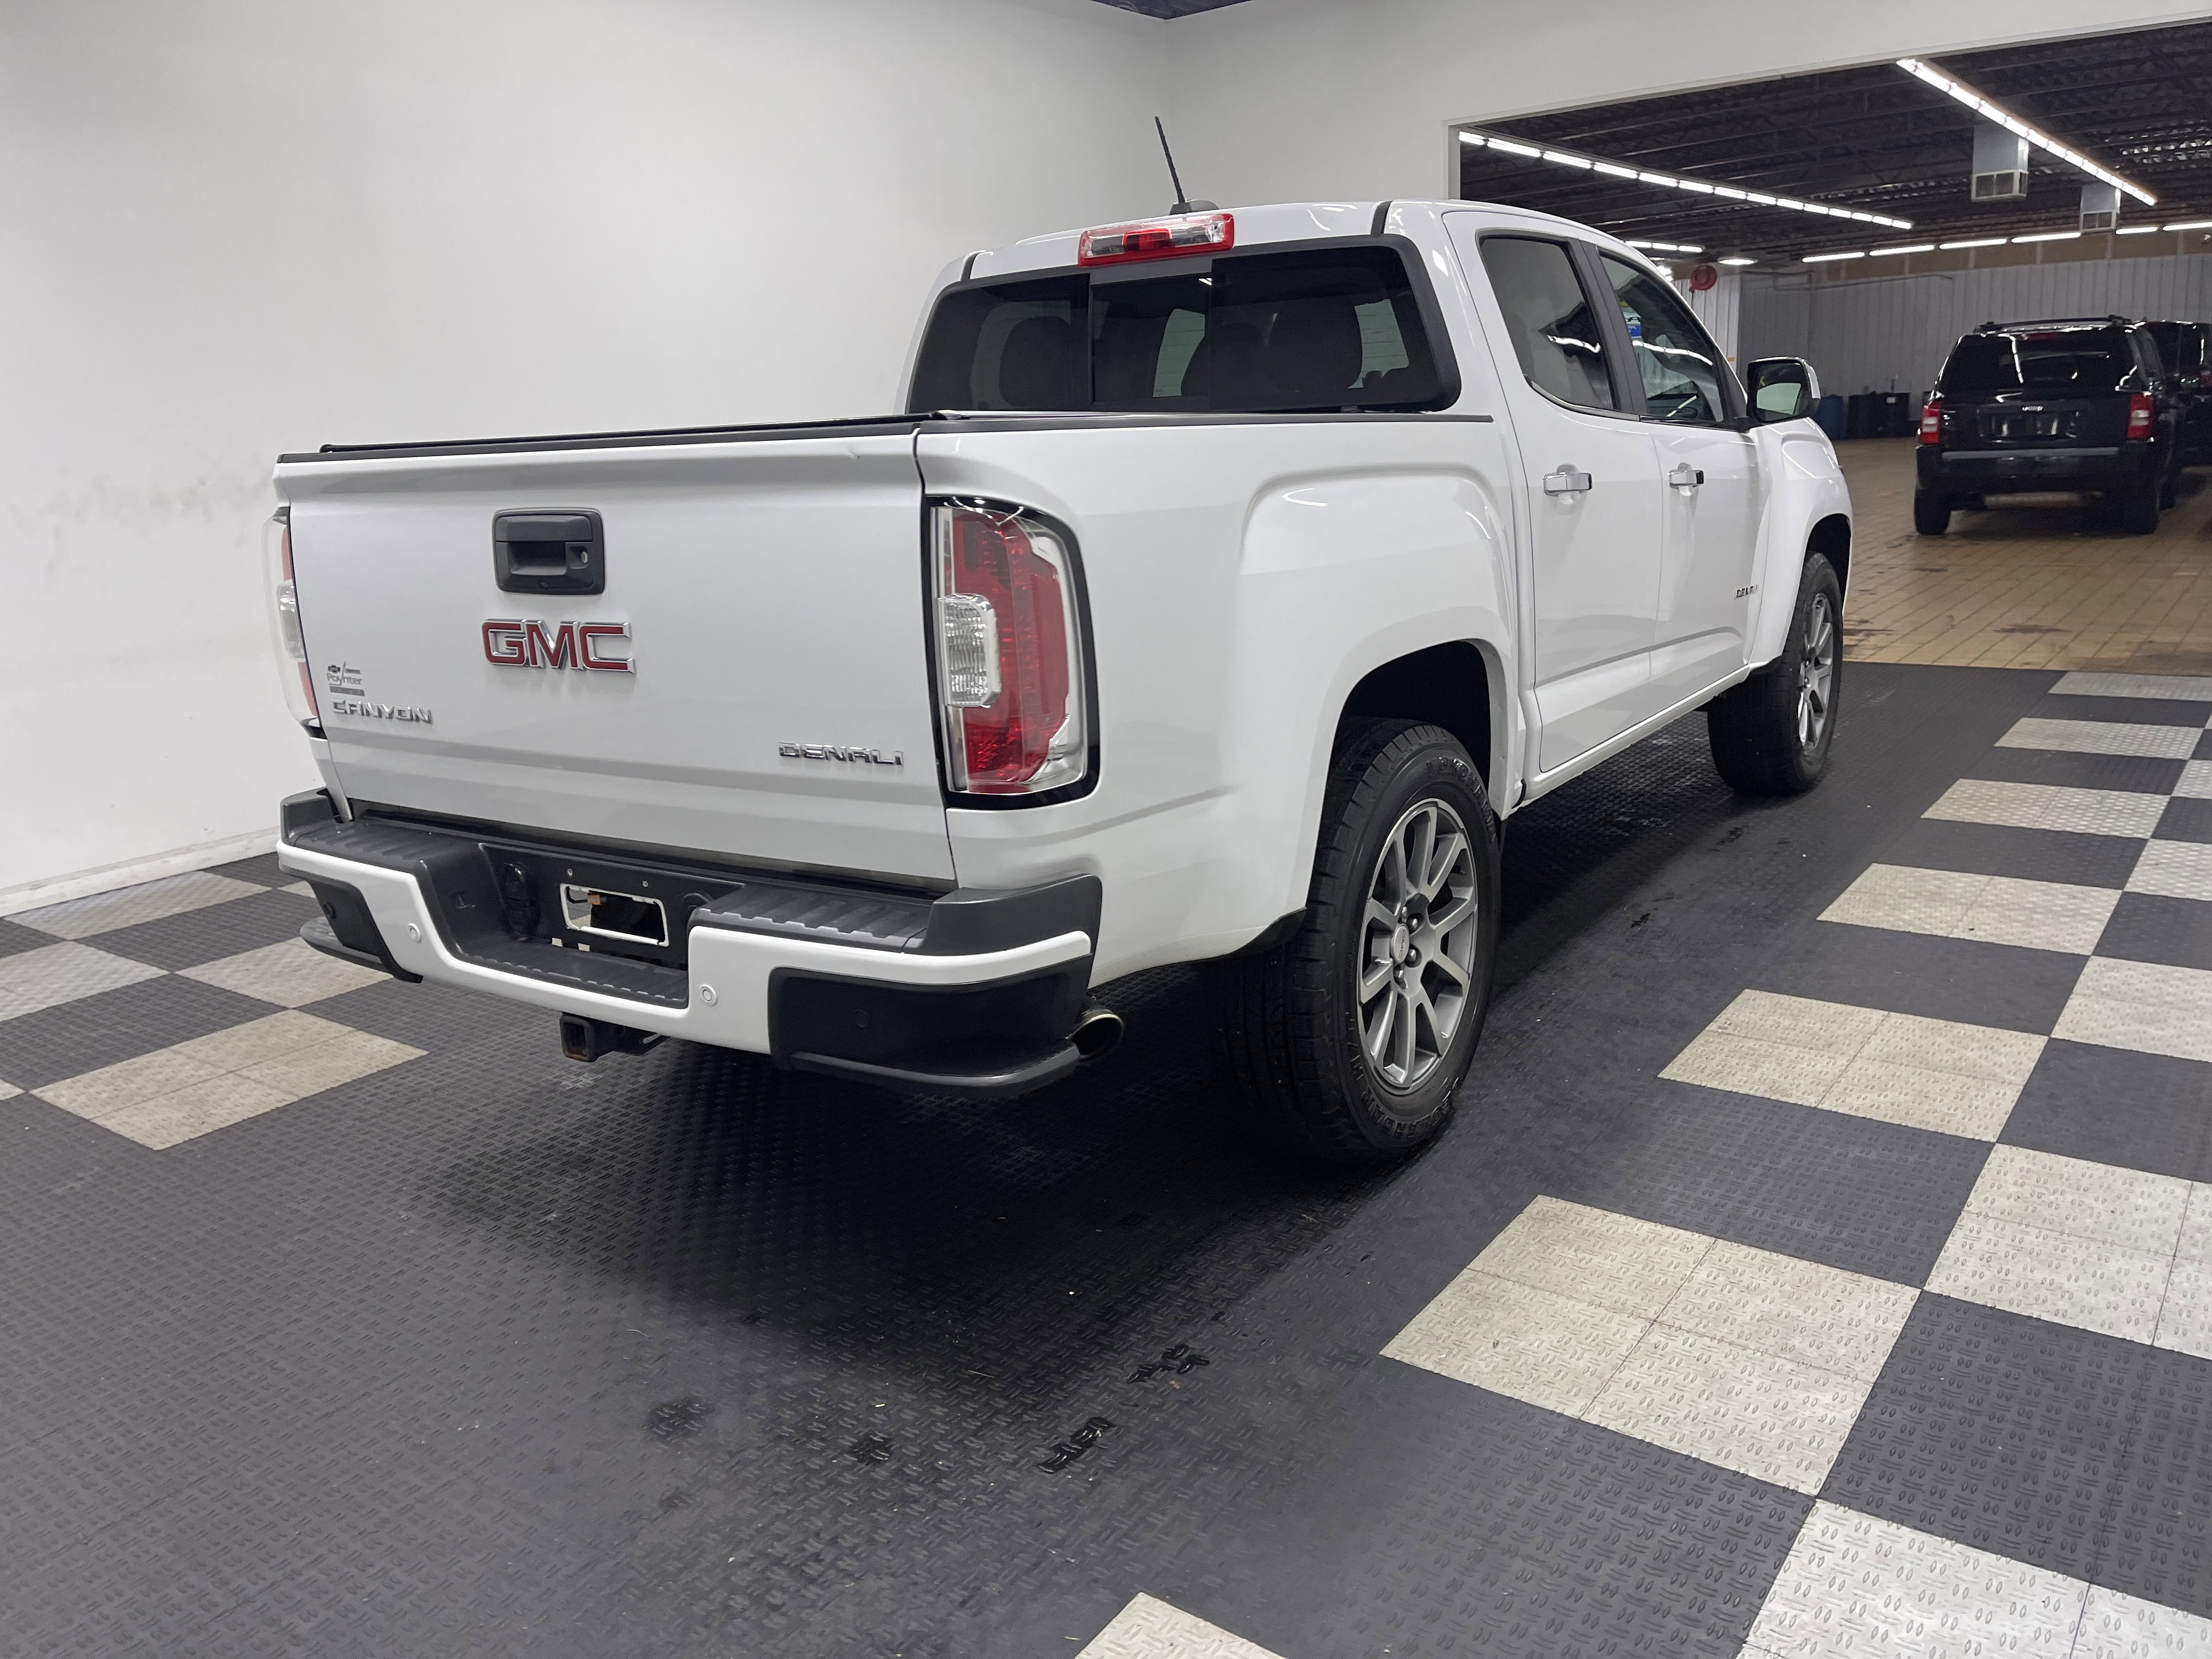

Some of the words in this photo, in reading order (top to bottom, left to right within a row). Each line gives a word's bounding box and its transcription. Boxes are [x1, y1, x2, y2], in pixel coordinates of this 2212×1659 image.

[482, 619, 636, 674] GMC
[326, 668, 362, 686] Poynter
[330, 698, 432, 724] CANYON
[778, 742, 904, 766] DENALI
